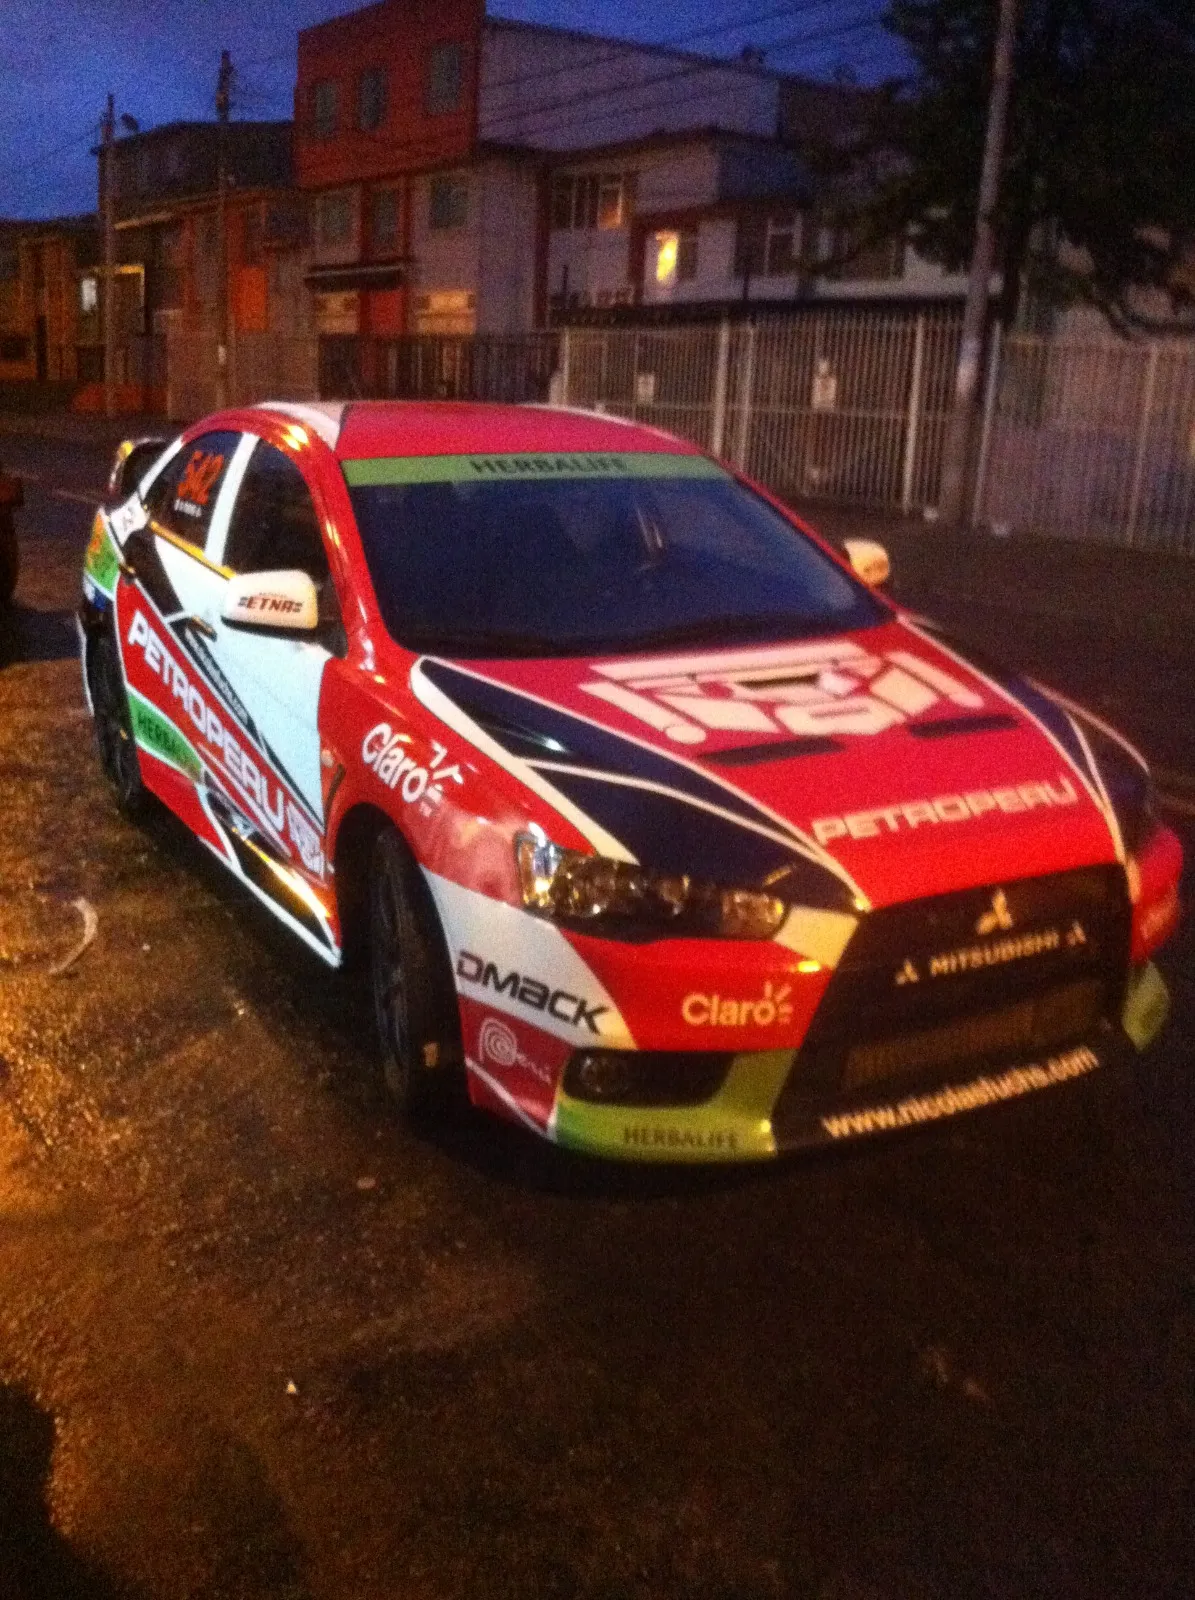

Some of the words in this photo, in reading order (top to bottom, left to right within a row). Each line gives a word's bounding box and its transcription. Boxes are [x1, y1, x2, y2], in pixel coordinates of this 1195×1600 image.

[470, 457, 627, 473] HERBALIFE
[246, 596, 294, 613] ETNA
[127, 608, 284, 832] PETROPERU
[362, 723, 428, 803] Claro
[811, 774, 1079, 844] PETROPERU
[930, 928, 1060, 977] MITSUBISHI
[682, 992, 776, 1026] Claro
[623, 1127, 738, 1151] HERBALIFE
